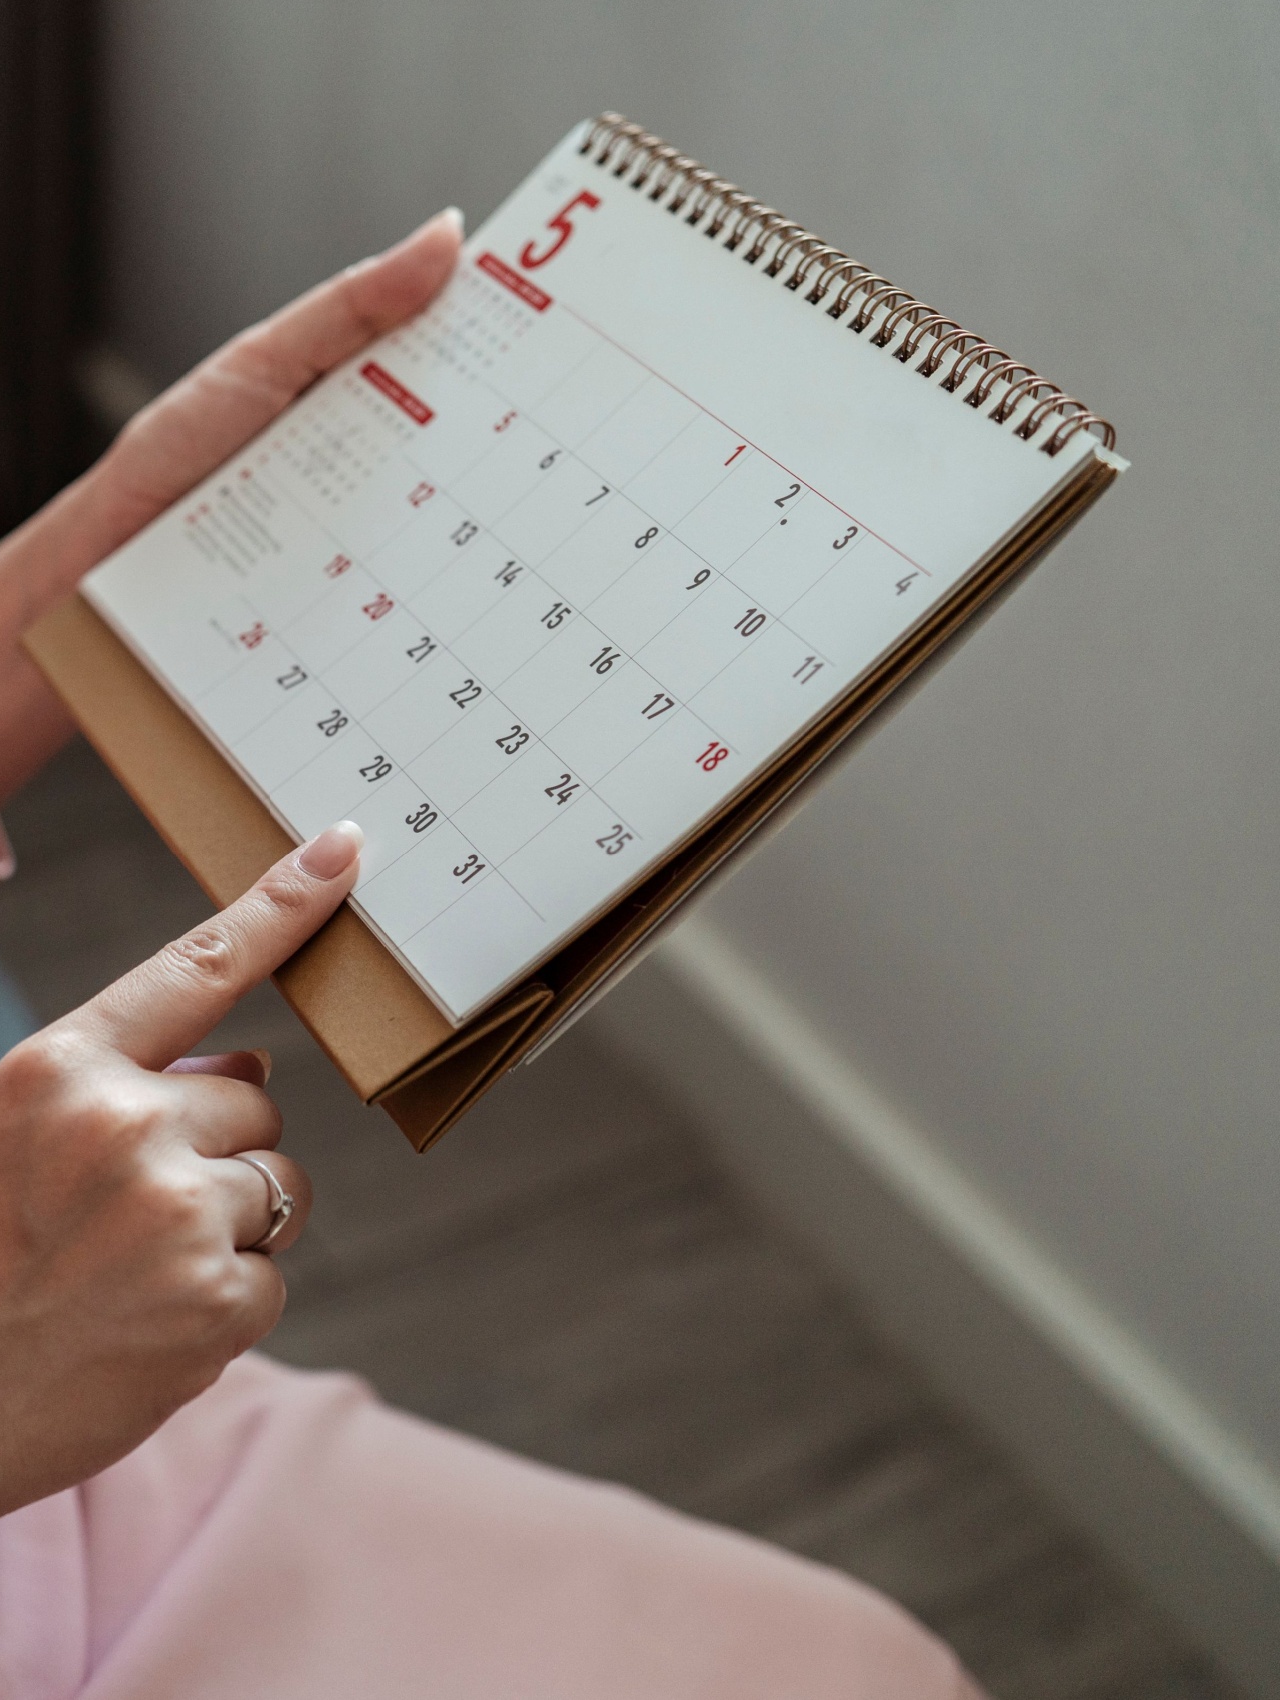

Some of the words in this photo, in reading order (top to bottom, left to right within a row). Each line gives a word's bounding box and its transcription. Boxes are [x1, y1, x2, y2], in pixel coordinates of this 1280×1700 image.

[518, 190, 601, 271] 5
[493, 411, 518, 433] 5
[539, 449, 562, 470] 6
[585, 485, 610, 506] 7
[635, 527, 658, 548] 8
[686, 569, 710, 590] 9
[734, 608, 766, 637] 10
[793, 656, 824, 685] 11
[724, 445, 746, 466] 1
[774, 484, 801, 508] 2
[833, 526, 858, 550] 3
[896, 572, 919, 595] 4
[362, 593, 394, 621] 20
[406, 636, 437, 663] 21
[449, 679, 482, 709] 22
[495, 725, 529, 755] 23
[544, 774, 580, 805] 24
[596, 824, 633, 855] 25
[451, 520, 478, 546] 13
[495, 561, 523, 587] 14
[541, 603, 571, 629] 15
[590, 647, 621, 674] 16
[641, 694, 675, 719] 17
[696, 742, 728, 771] 18
[276, 665, 308, 690] 27
[317, 709, 348, 737] 28
[359, 755, 392, 782] 29
[405, 803, 437, 833] 30
[453, 854, 485, 884] 31
